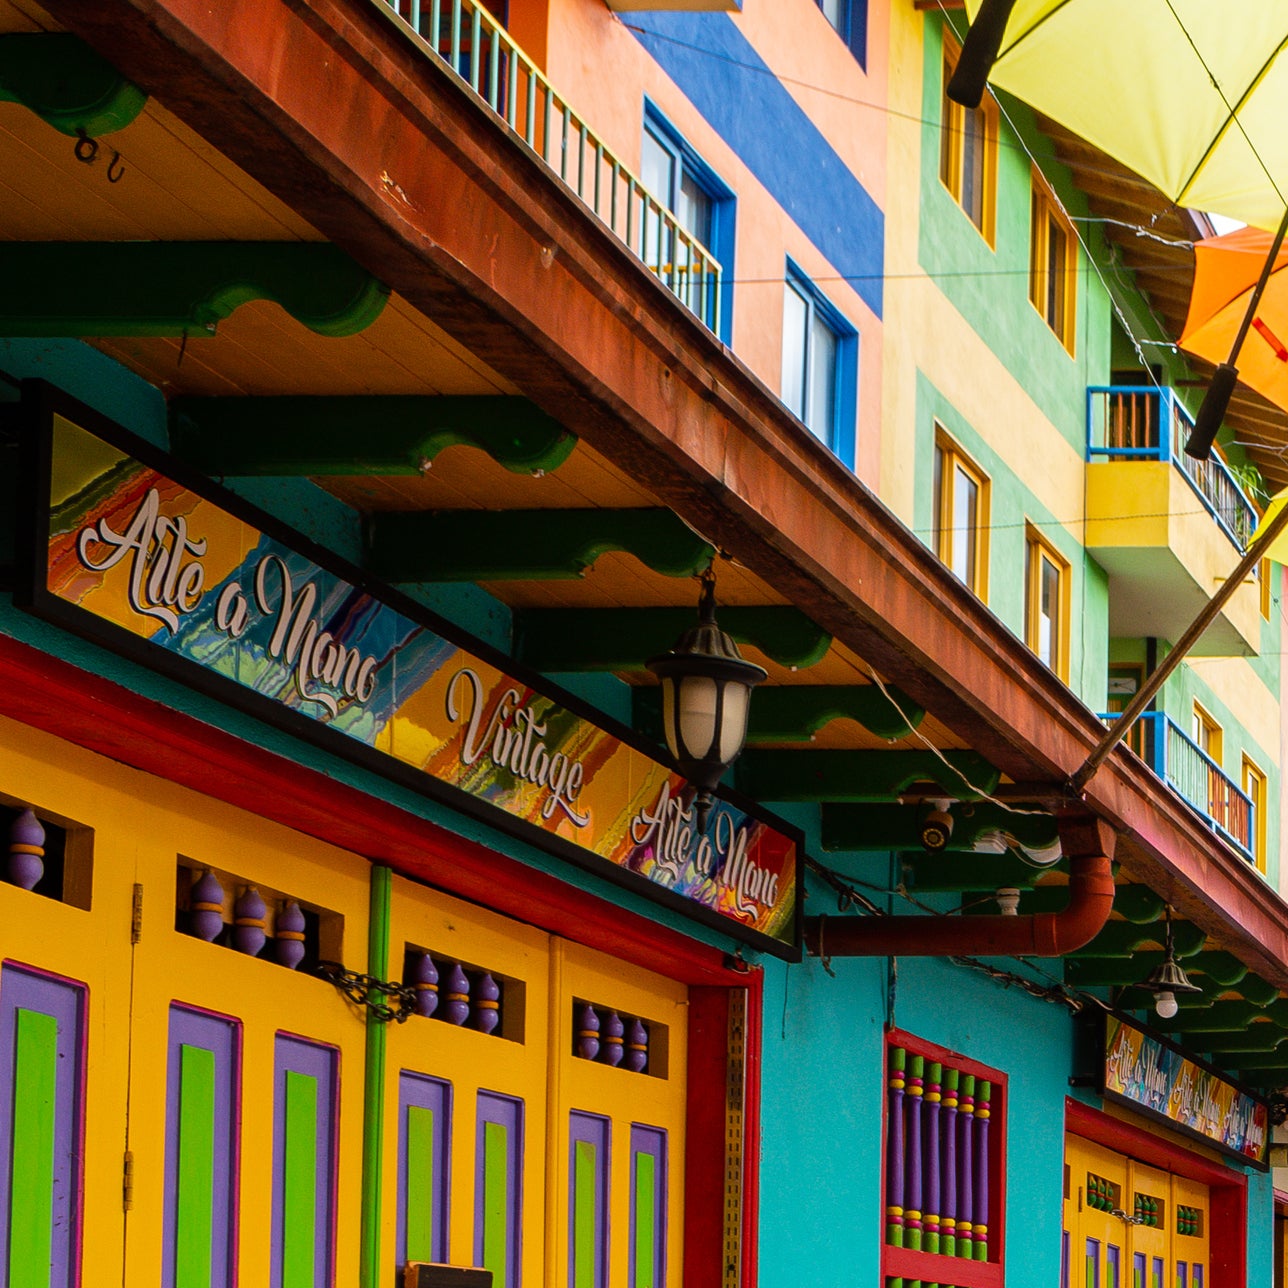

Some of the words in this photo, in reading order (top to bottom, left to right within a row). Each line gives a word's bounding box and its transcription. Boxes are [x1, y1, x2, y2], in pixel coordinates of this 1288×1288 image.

[78, 488, 208, 634] Arte
[215, 581, 249, 639] a
[253, 553, 379, 720] Mano
[446, 667, 590, 829] Vintage
[631, 780, 693, 882] Arte
[696, 833, 713, 876] a
[716, 811, 779, 922] Mano
